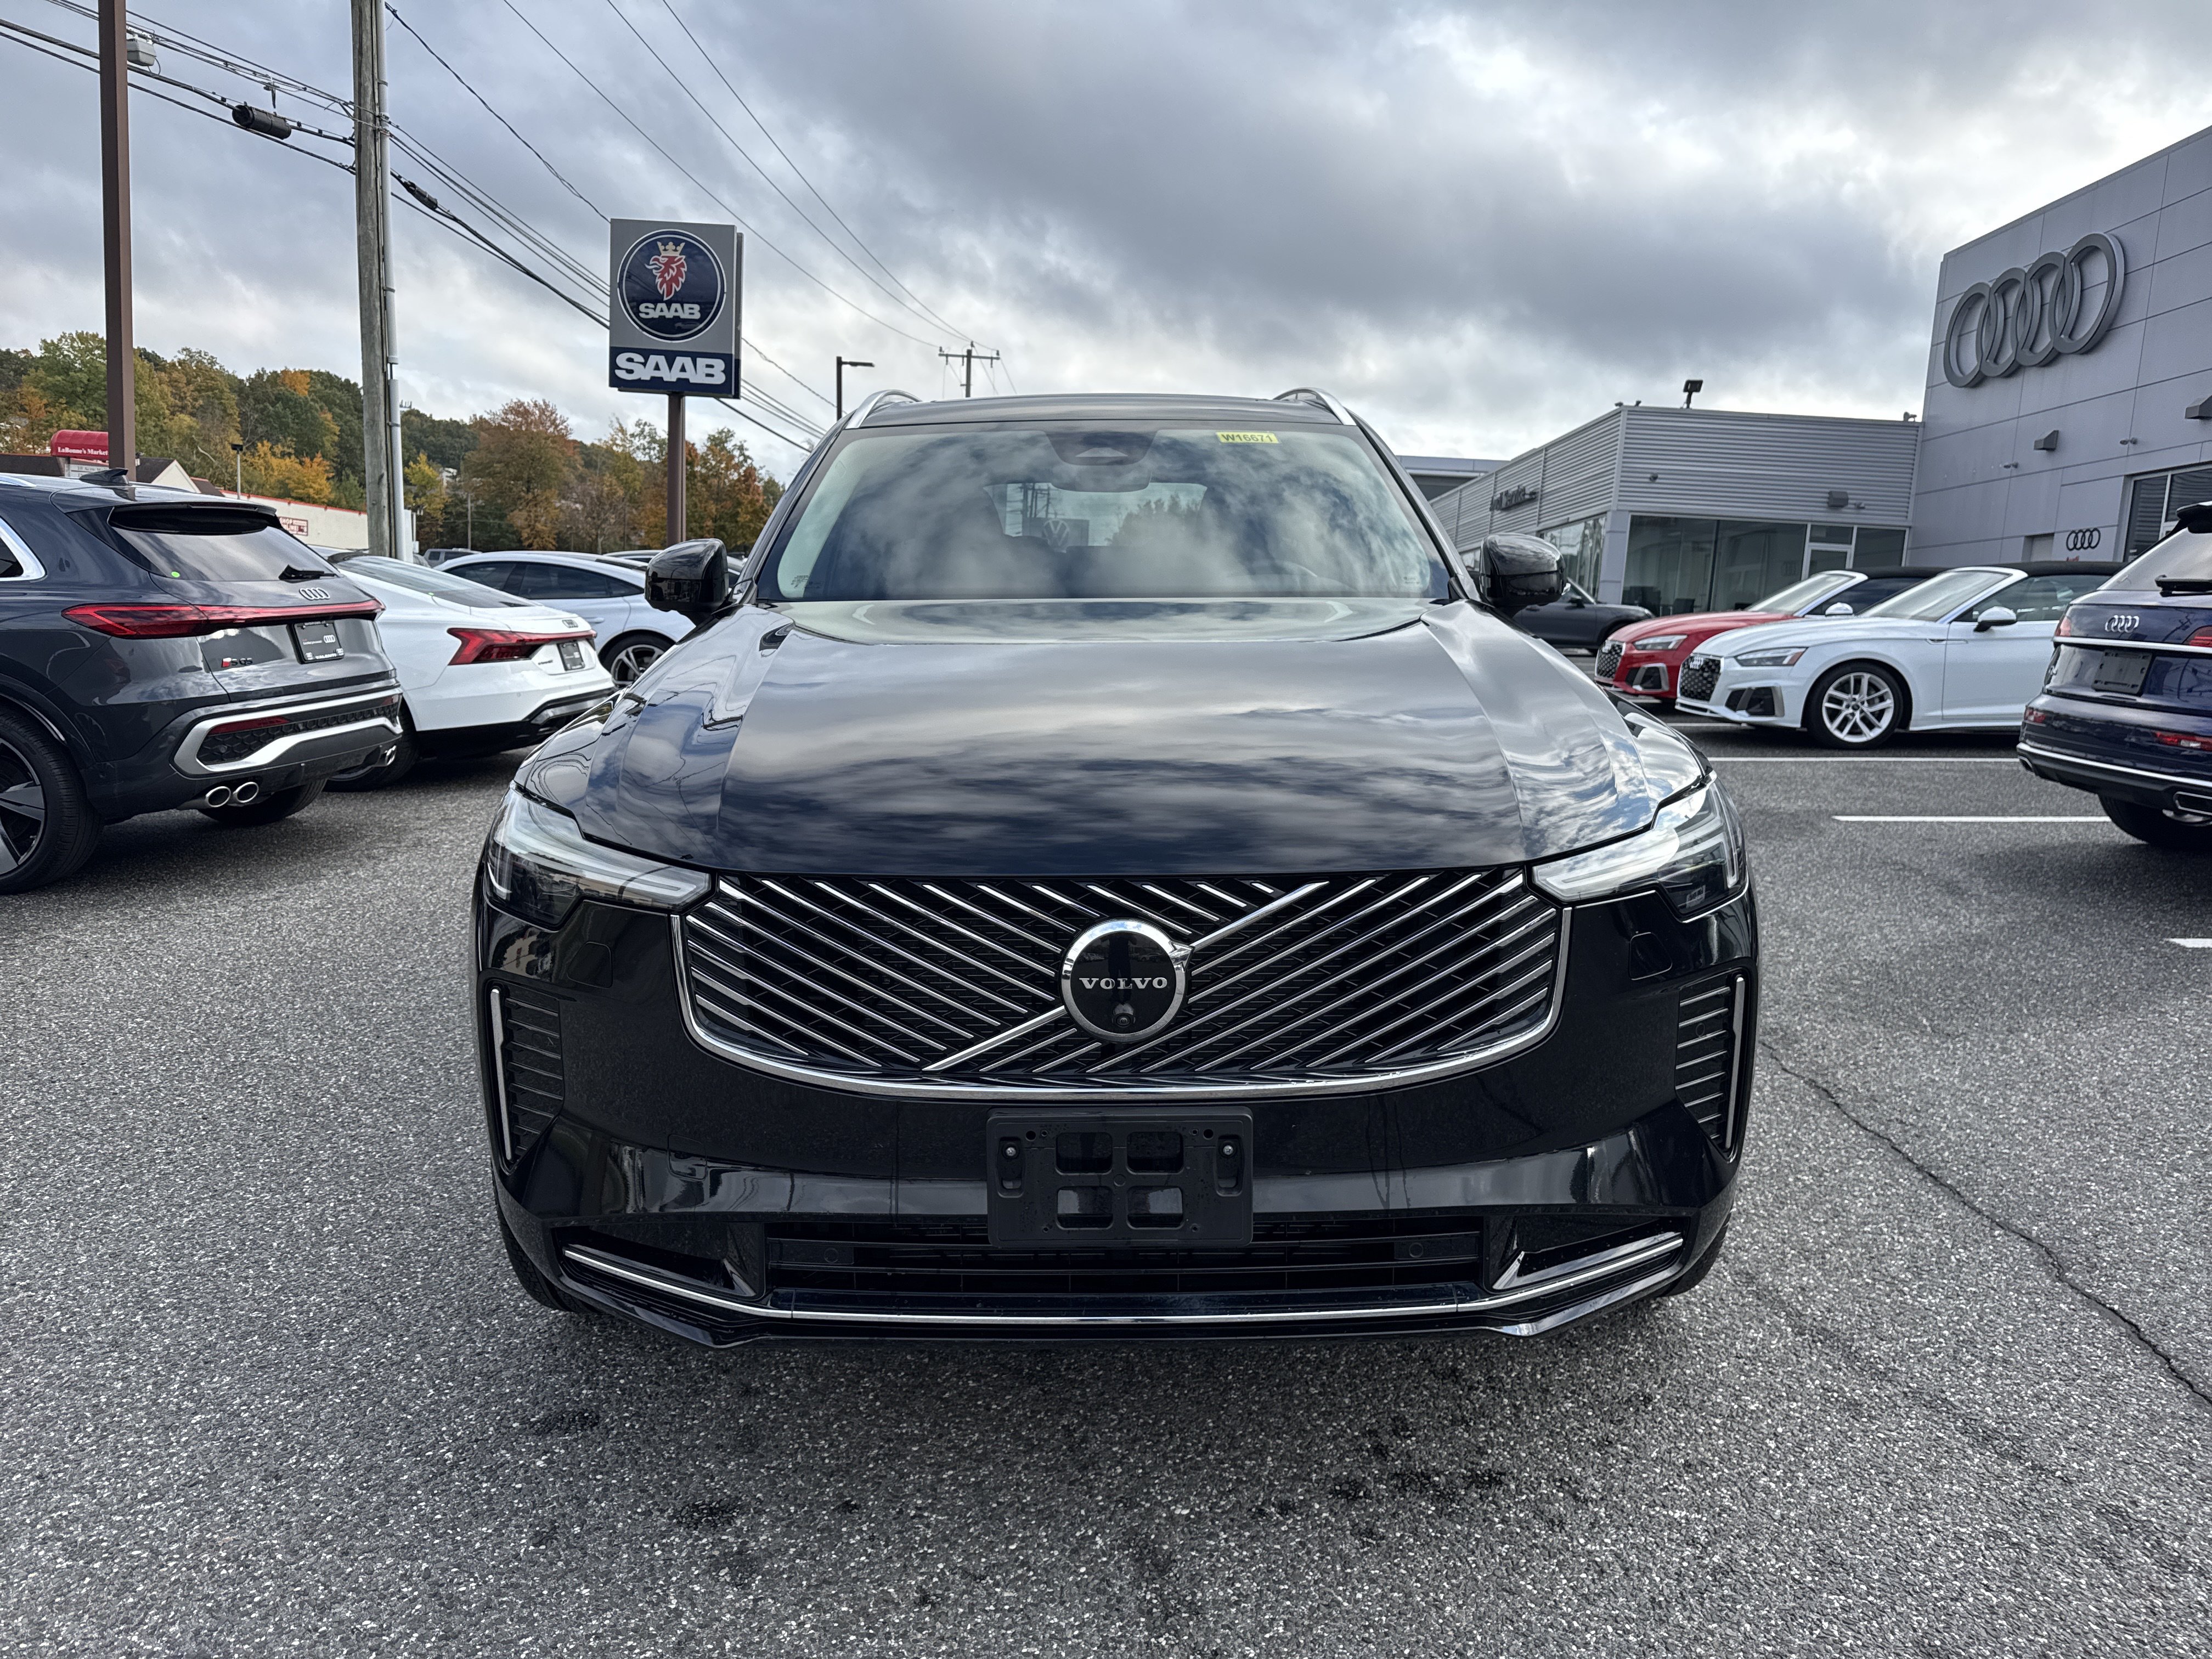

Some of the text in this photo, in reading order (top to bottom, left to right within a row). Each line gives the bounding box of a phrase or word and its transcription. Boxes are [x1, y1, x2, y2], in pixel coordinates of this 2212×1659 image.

[639, 302, 701, 319] SAAB
[614, 352, 726, 384] SAAB
[1221, 434, 1273, 442] W16671
[1079, 977, 1168, 990] VOLVO
